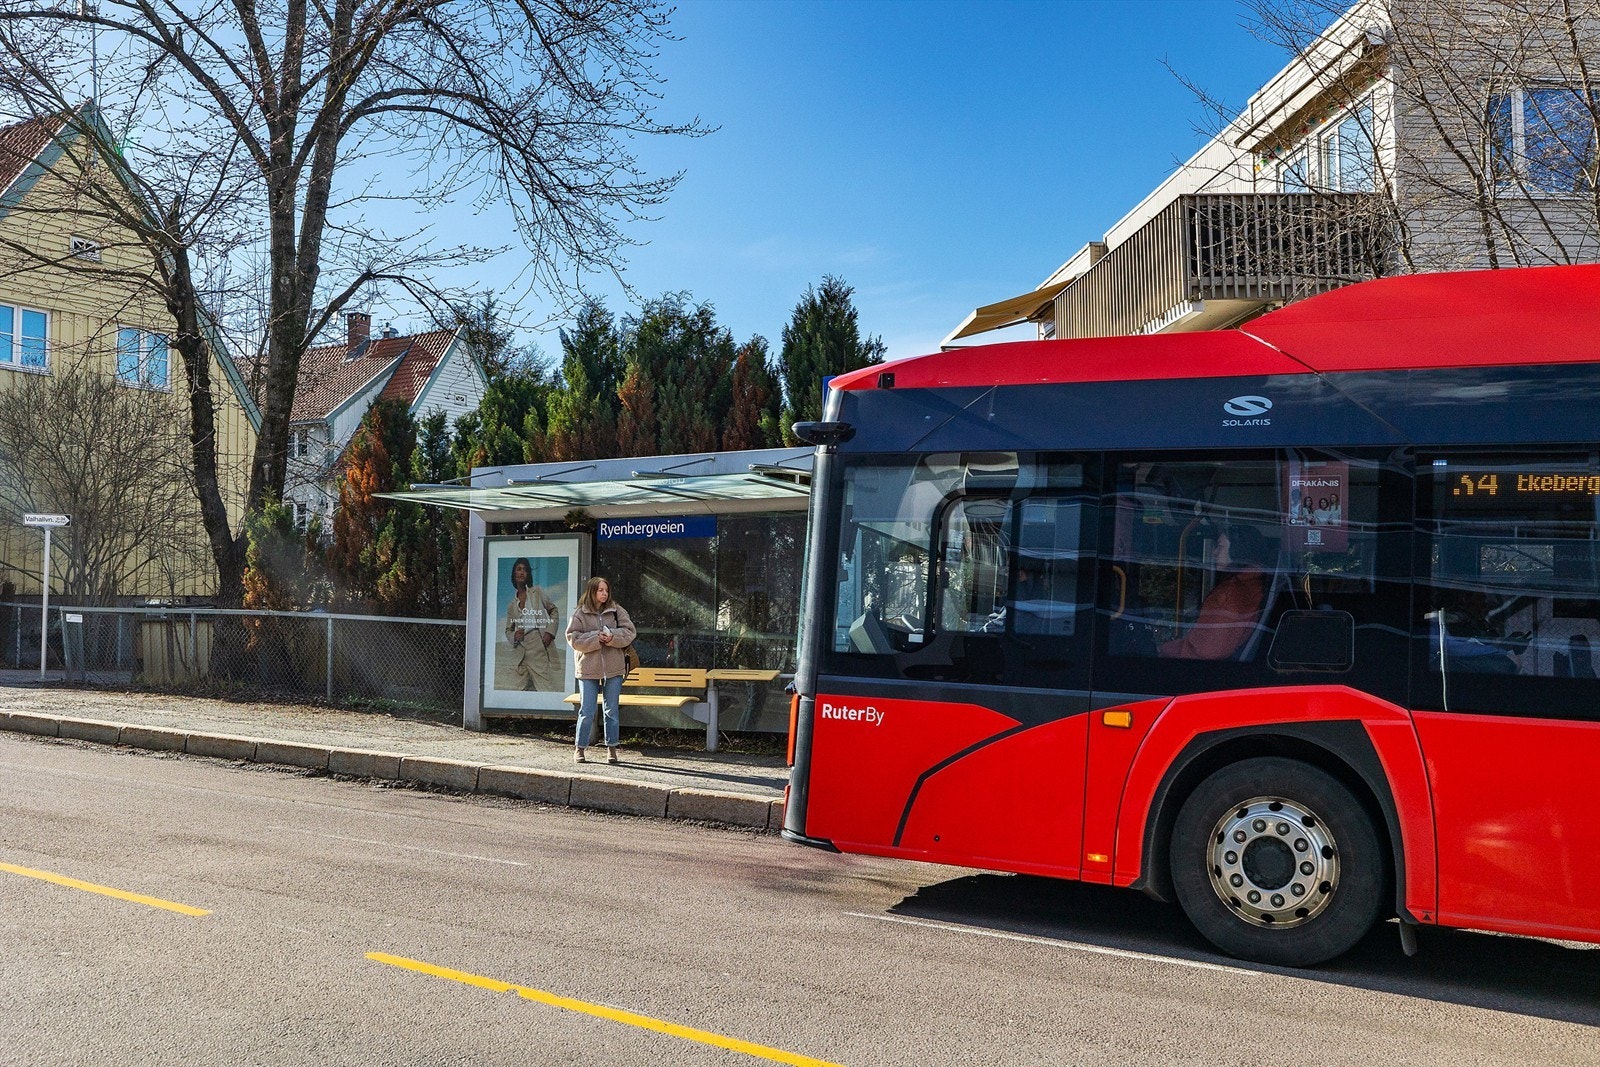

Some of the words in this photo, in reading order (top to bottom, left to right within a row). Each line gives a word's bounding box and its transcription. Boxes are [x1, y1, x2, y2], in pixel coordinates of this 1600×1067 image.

[1222, 418, 1271, 427] SOLARIS
[600, 520, 685, 538] Ryenbergveien
[521, 607, 543, 616] Cubus
[822, 703, 885, 726] RuterBy
